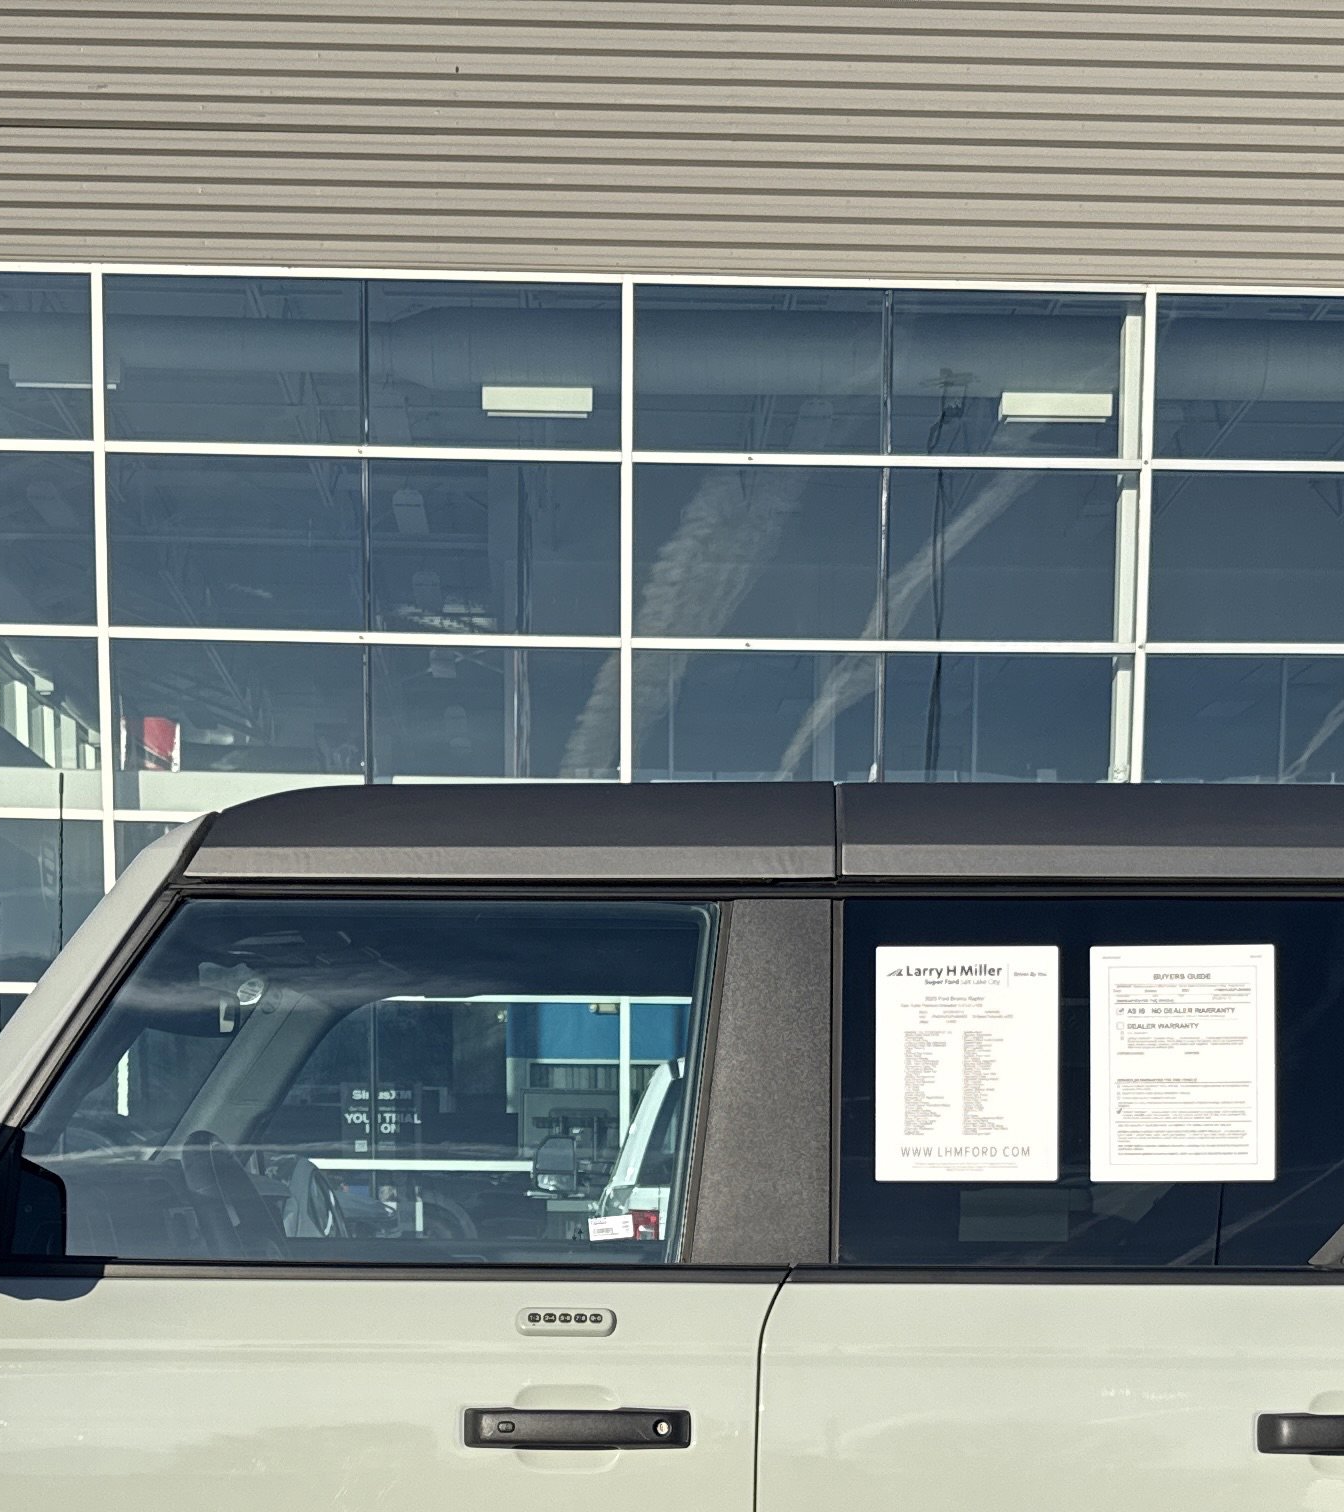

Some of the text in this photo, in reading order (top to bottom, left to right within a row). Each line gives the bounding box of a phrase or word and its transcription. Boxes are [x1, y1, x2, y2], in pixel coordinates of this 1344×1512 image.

[906, 963, 1003, 979] Larry H Miller
[1153, 973, 1185, 981] BUYERS
